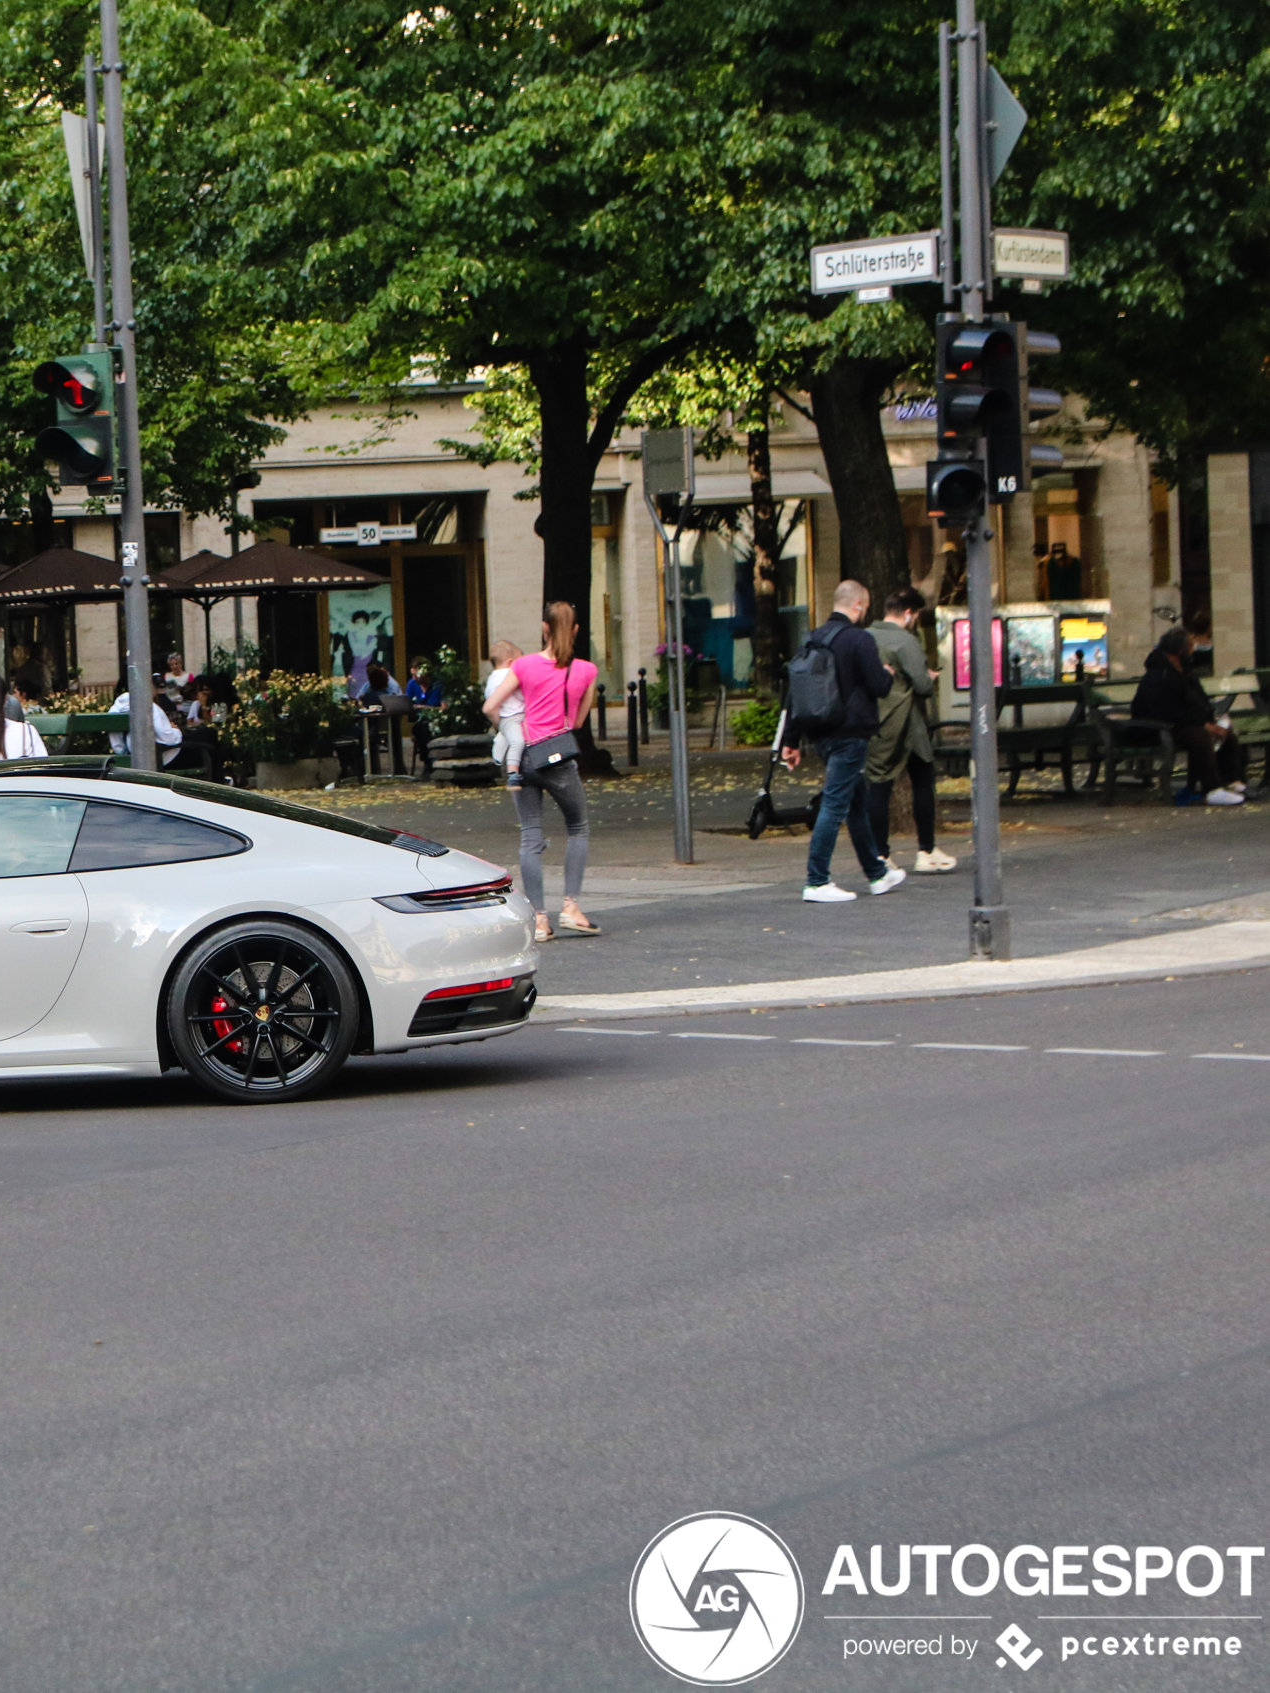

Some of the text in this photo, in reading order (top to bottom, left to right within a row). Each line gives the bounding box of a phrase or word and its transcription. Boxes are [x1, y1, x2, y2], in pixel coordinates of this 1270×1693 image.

[824, 246, 925, 278] Schlüterstraße
[997, 475, 1017, 493] K6
[361, 527, 377, 540] 50
[194, 576, 366, 589] EINSTEIN KAFFEE
